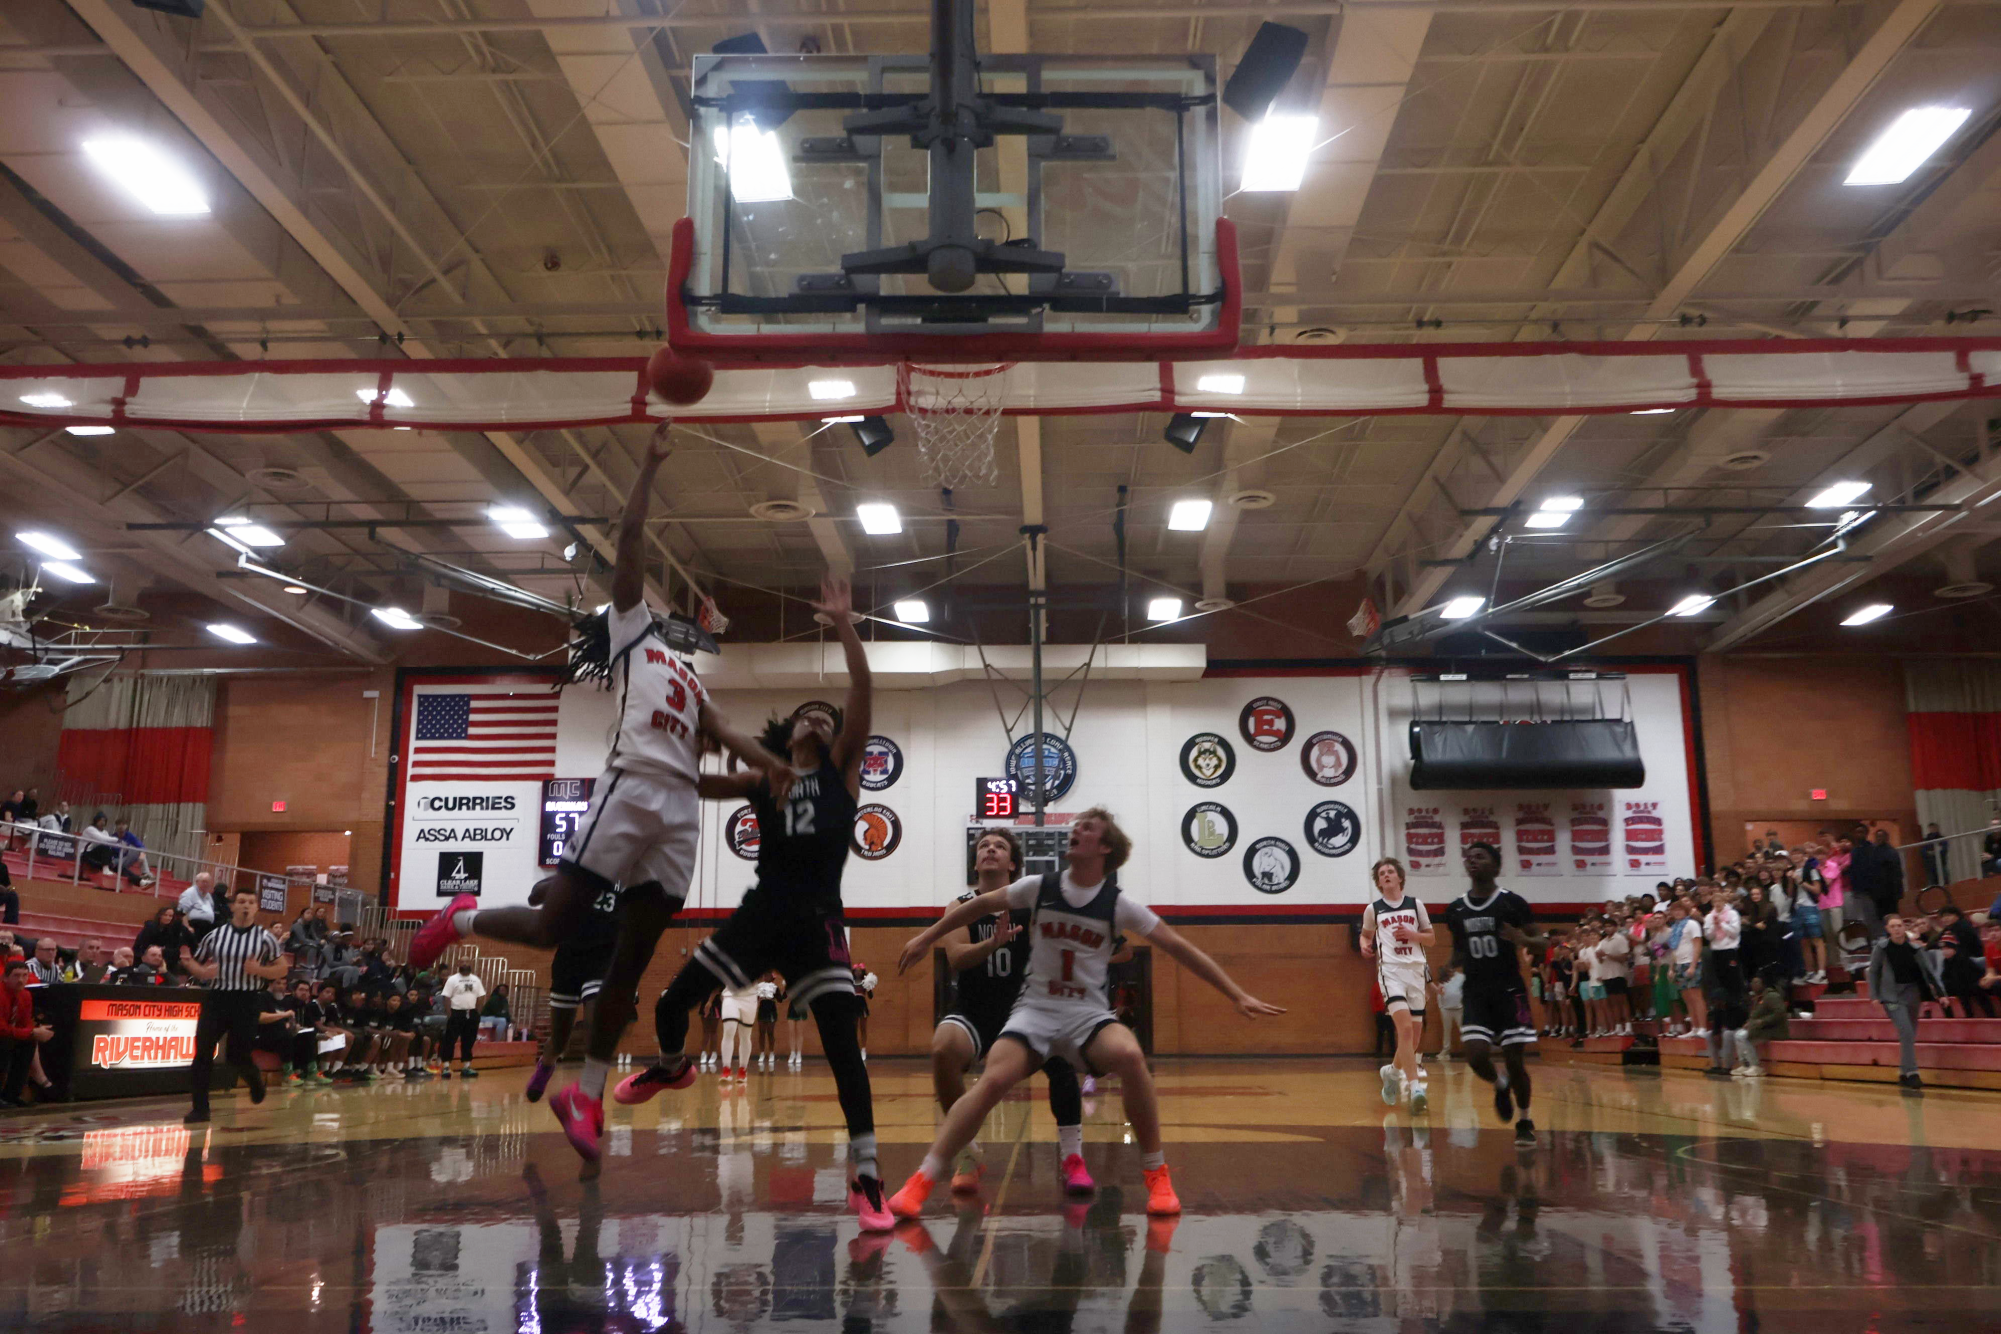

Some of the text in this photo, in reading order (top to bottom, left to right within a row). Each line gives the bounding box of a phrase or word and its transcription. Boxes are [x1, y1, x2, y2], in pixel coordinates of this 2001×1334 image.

[644, 648, 702, 707] MASON
[665, 678, 686, 713] 3
[651, 709, 689, 740] CITY
[1250, 708, 1285, 739] E
[861, 780, 889, 789] BOBCATS
[986, 780, 1017, 793] 4:57
[429, 795, 516, 812] CURRIES
[985, 793, 1012, 815] 33
[554, 812, 580, 833] 57
[784, 799, 815, 837] 12
[882, 810, 895, 822] EAST
[415, 827, 515, 843] ASSA ABLOY
[547, 833, 566, 841] FOULS
[553, 840, 563, 856] 0
[860, 849, 887, 857] TROJANS
[262, 889, 284, 901] VISITING
[260, 900, 283, 912] STUDENTS
[1380, 914, 1415, 929] MASON
[1393, 946, 1413, 956] CITY
[1468, 934, 1498, 959] 00
[987, 947, 1012, 978] 10
[1061, 949, 1076, 982] 1
[107, 1003, 201, 1018] MASON CITY HIGH SCH
[146, 1021, 163, 1034] Home
[92, 1034, 200, 1070] RIVERHAW
